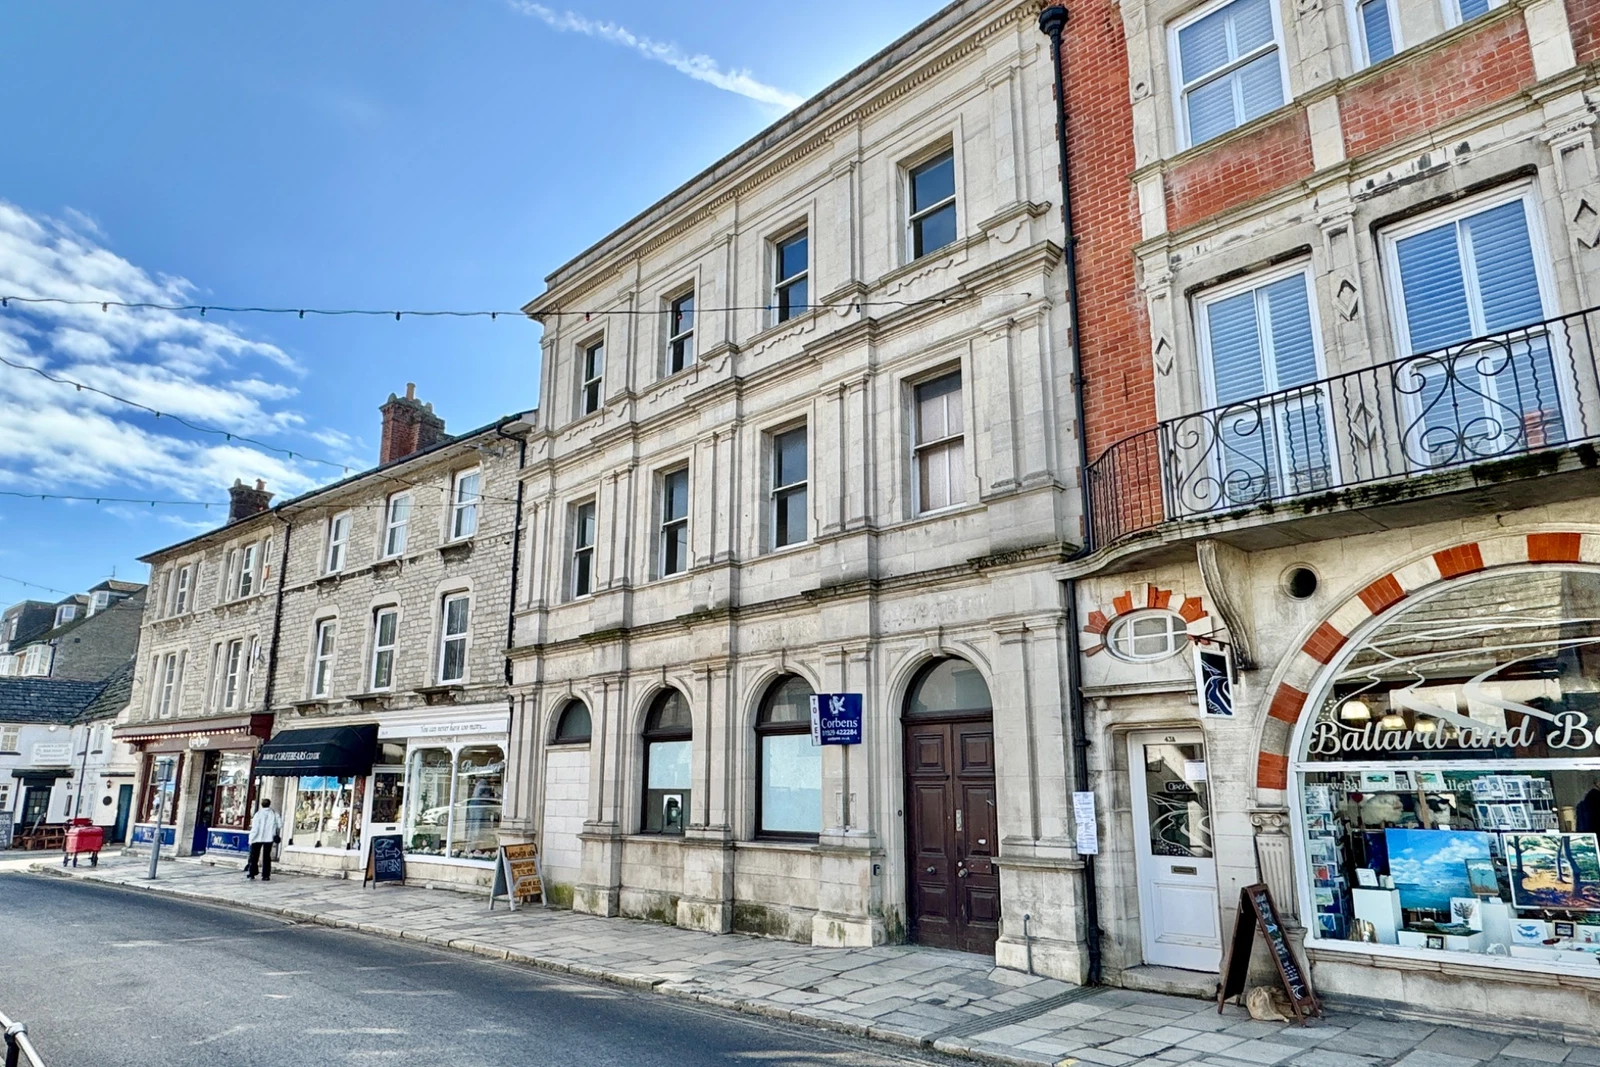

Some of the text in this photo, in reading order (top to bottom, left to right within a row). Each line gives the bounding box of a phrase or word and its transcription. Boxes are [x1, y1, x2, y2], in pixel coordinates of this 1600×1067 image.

[821, 717, 858, 729] Corbens
[1307, 710, 1600, 755] Ballard and B
